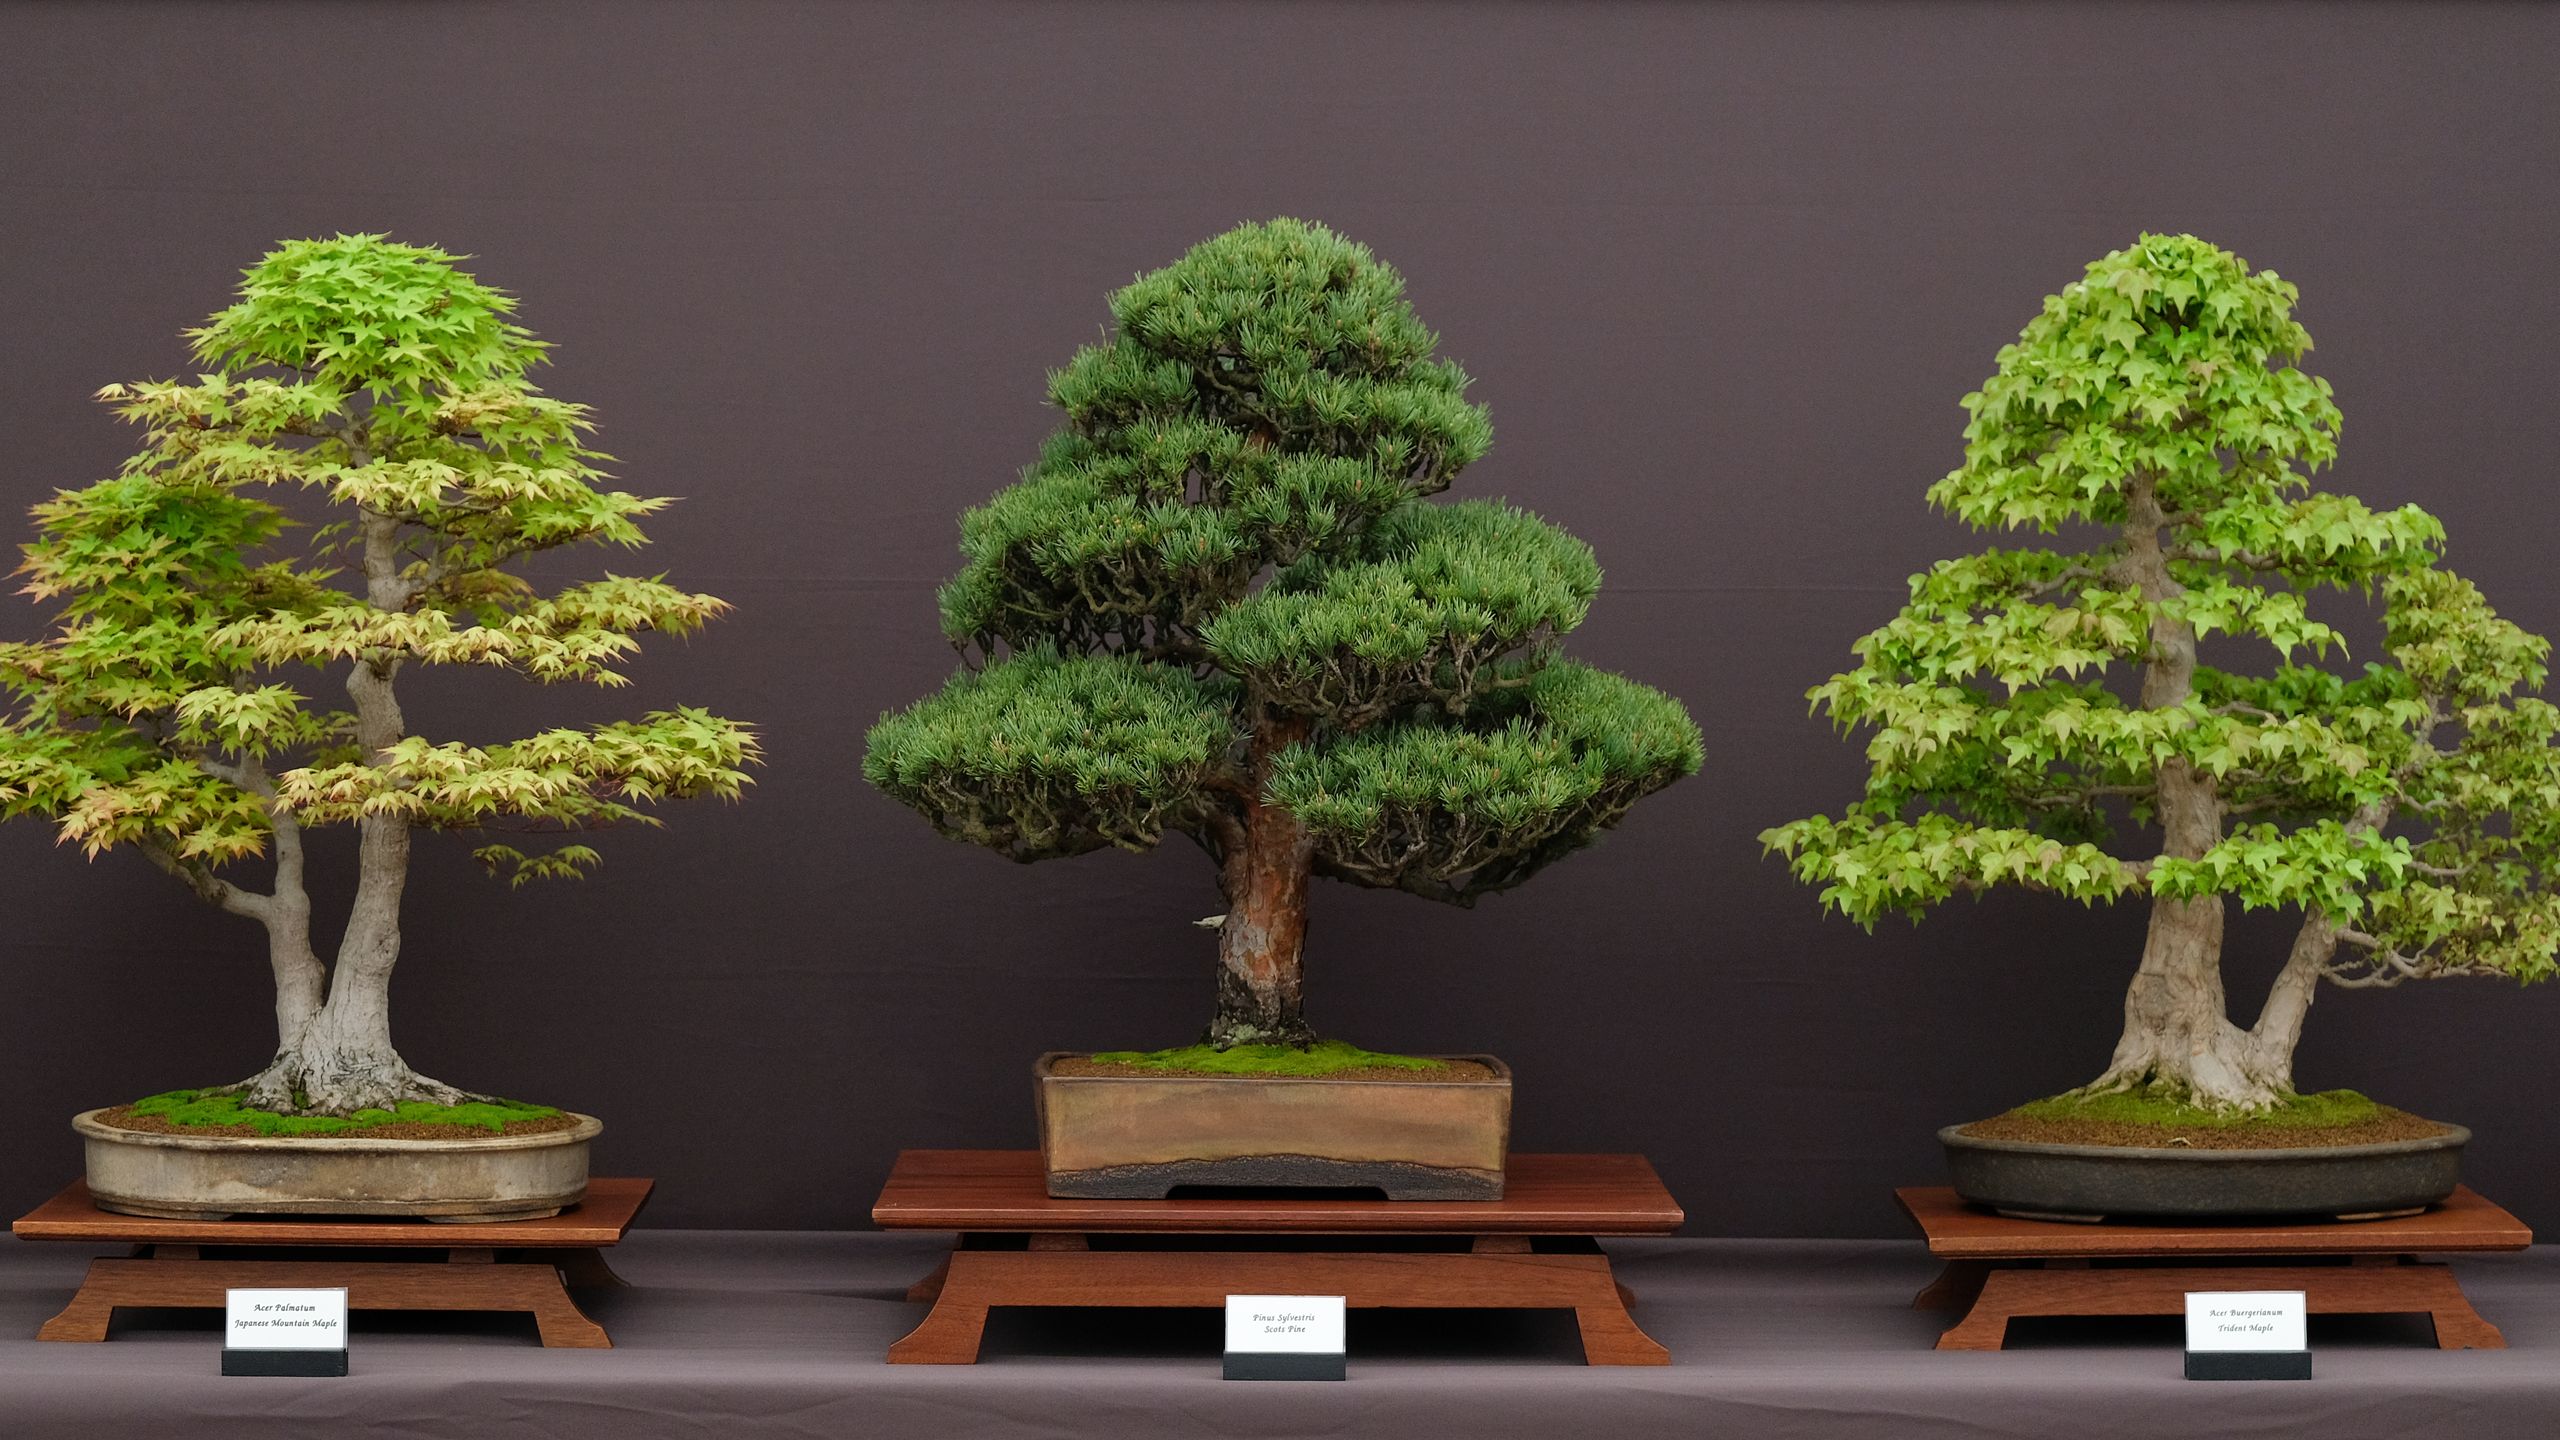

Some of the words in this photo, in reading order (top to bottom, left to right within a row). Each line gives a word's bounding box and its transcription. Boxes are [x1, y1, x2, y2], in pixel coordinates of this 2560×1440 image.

[254, 1304, 273, 1312] Acer
[275, 1303, 316, 1312] Palmatum
[1253, 1313, 1275, 1322] Pinus
[1277, 1313, 1315, 1324] Sylvestris
[2209, 1309, 2228, 1317] Acer
[2230, 1308, 2283, 1319] Buergerianum
[234, 1319, 269, 1329] Japanese
[271, 1319, 310, 1327] Mountain
[312, 1318, 337, 1329] Maple
[1264, 1325, 1285, 1333] Scots
[1287, 1325, 1306, 1333] Pine
[2217, 1324, 2247, 1332] Trident
[2249, 1323, 2274, 1334] Maple
